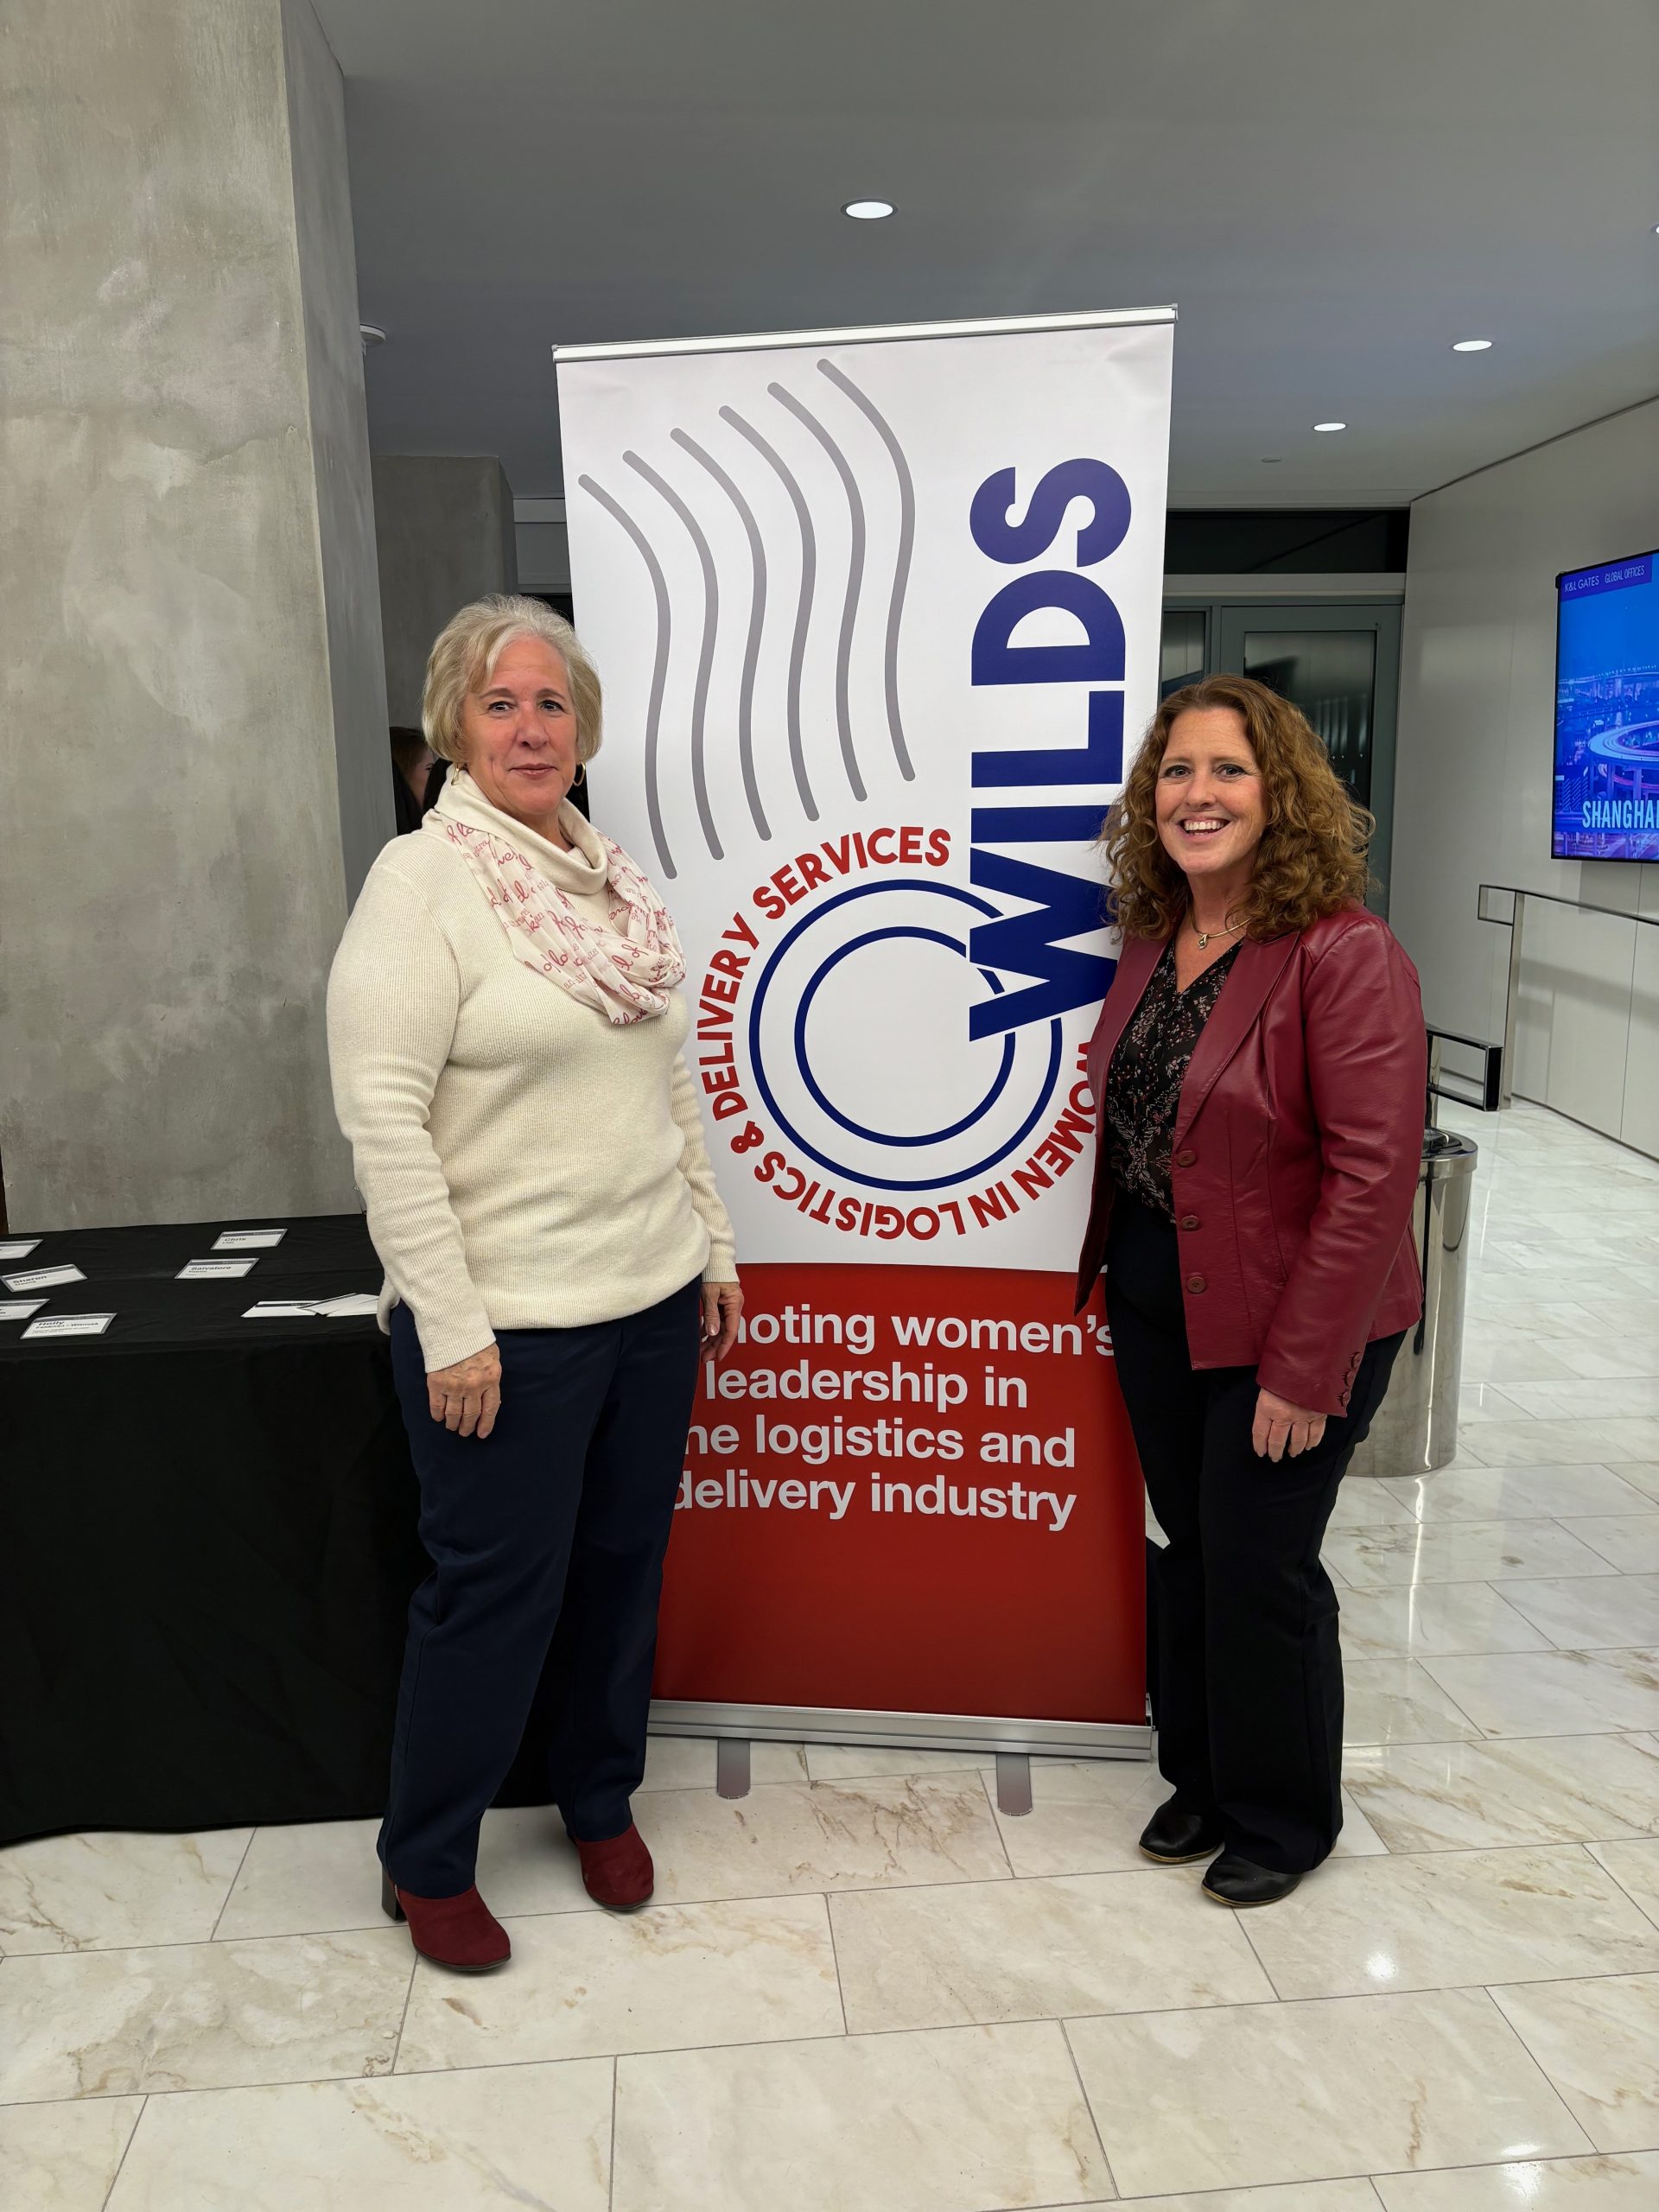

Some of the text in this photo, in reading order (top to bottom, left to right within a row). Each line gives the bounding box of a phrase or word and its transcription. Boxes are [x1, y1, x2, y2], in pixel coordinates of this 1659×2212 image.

[1578, 575, 1599, 589] GATES
[1605, 569, 1624, 583] GLOBAL
[1624, 564, 1645, 579] OFFICES
[969, 457, 1131, 1041] WILDS
[753, 826, 951, 920] SERVICES
[696, 912, 760, 1121] DELIVERY
[730, 1121, 764, 1154] &
[753, 1152, 965, 1241] LOGISTICS
[968, 1182, 1020, 1228] IN
[892, 1314, 1115, 1356] women's
[706, 1359, 1027, 1413] leadership in
[756, 1414, 964, 1464] logistics
[980, 1427, 1075, 1467] and
[871, 1471, 1077, 1531] industry
